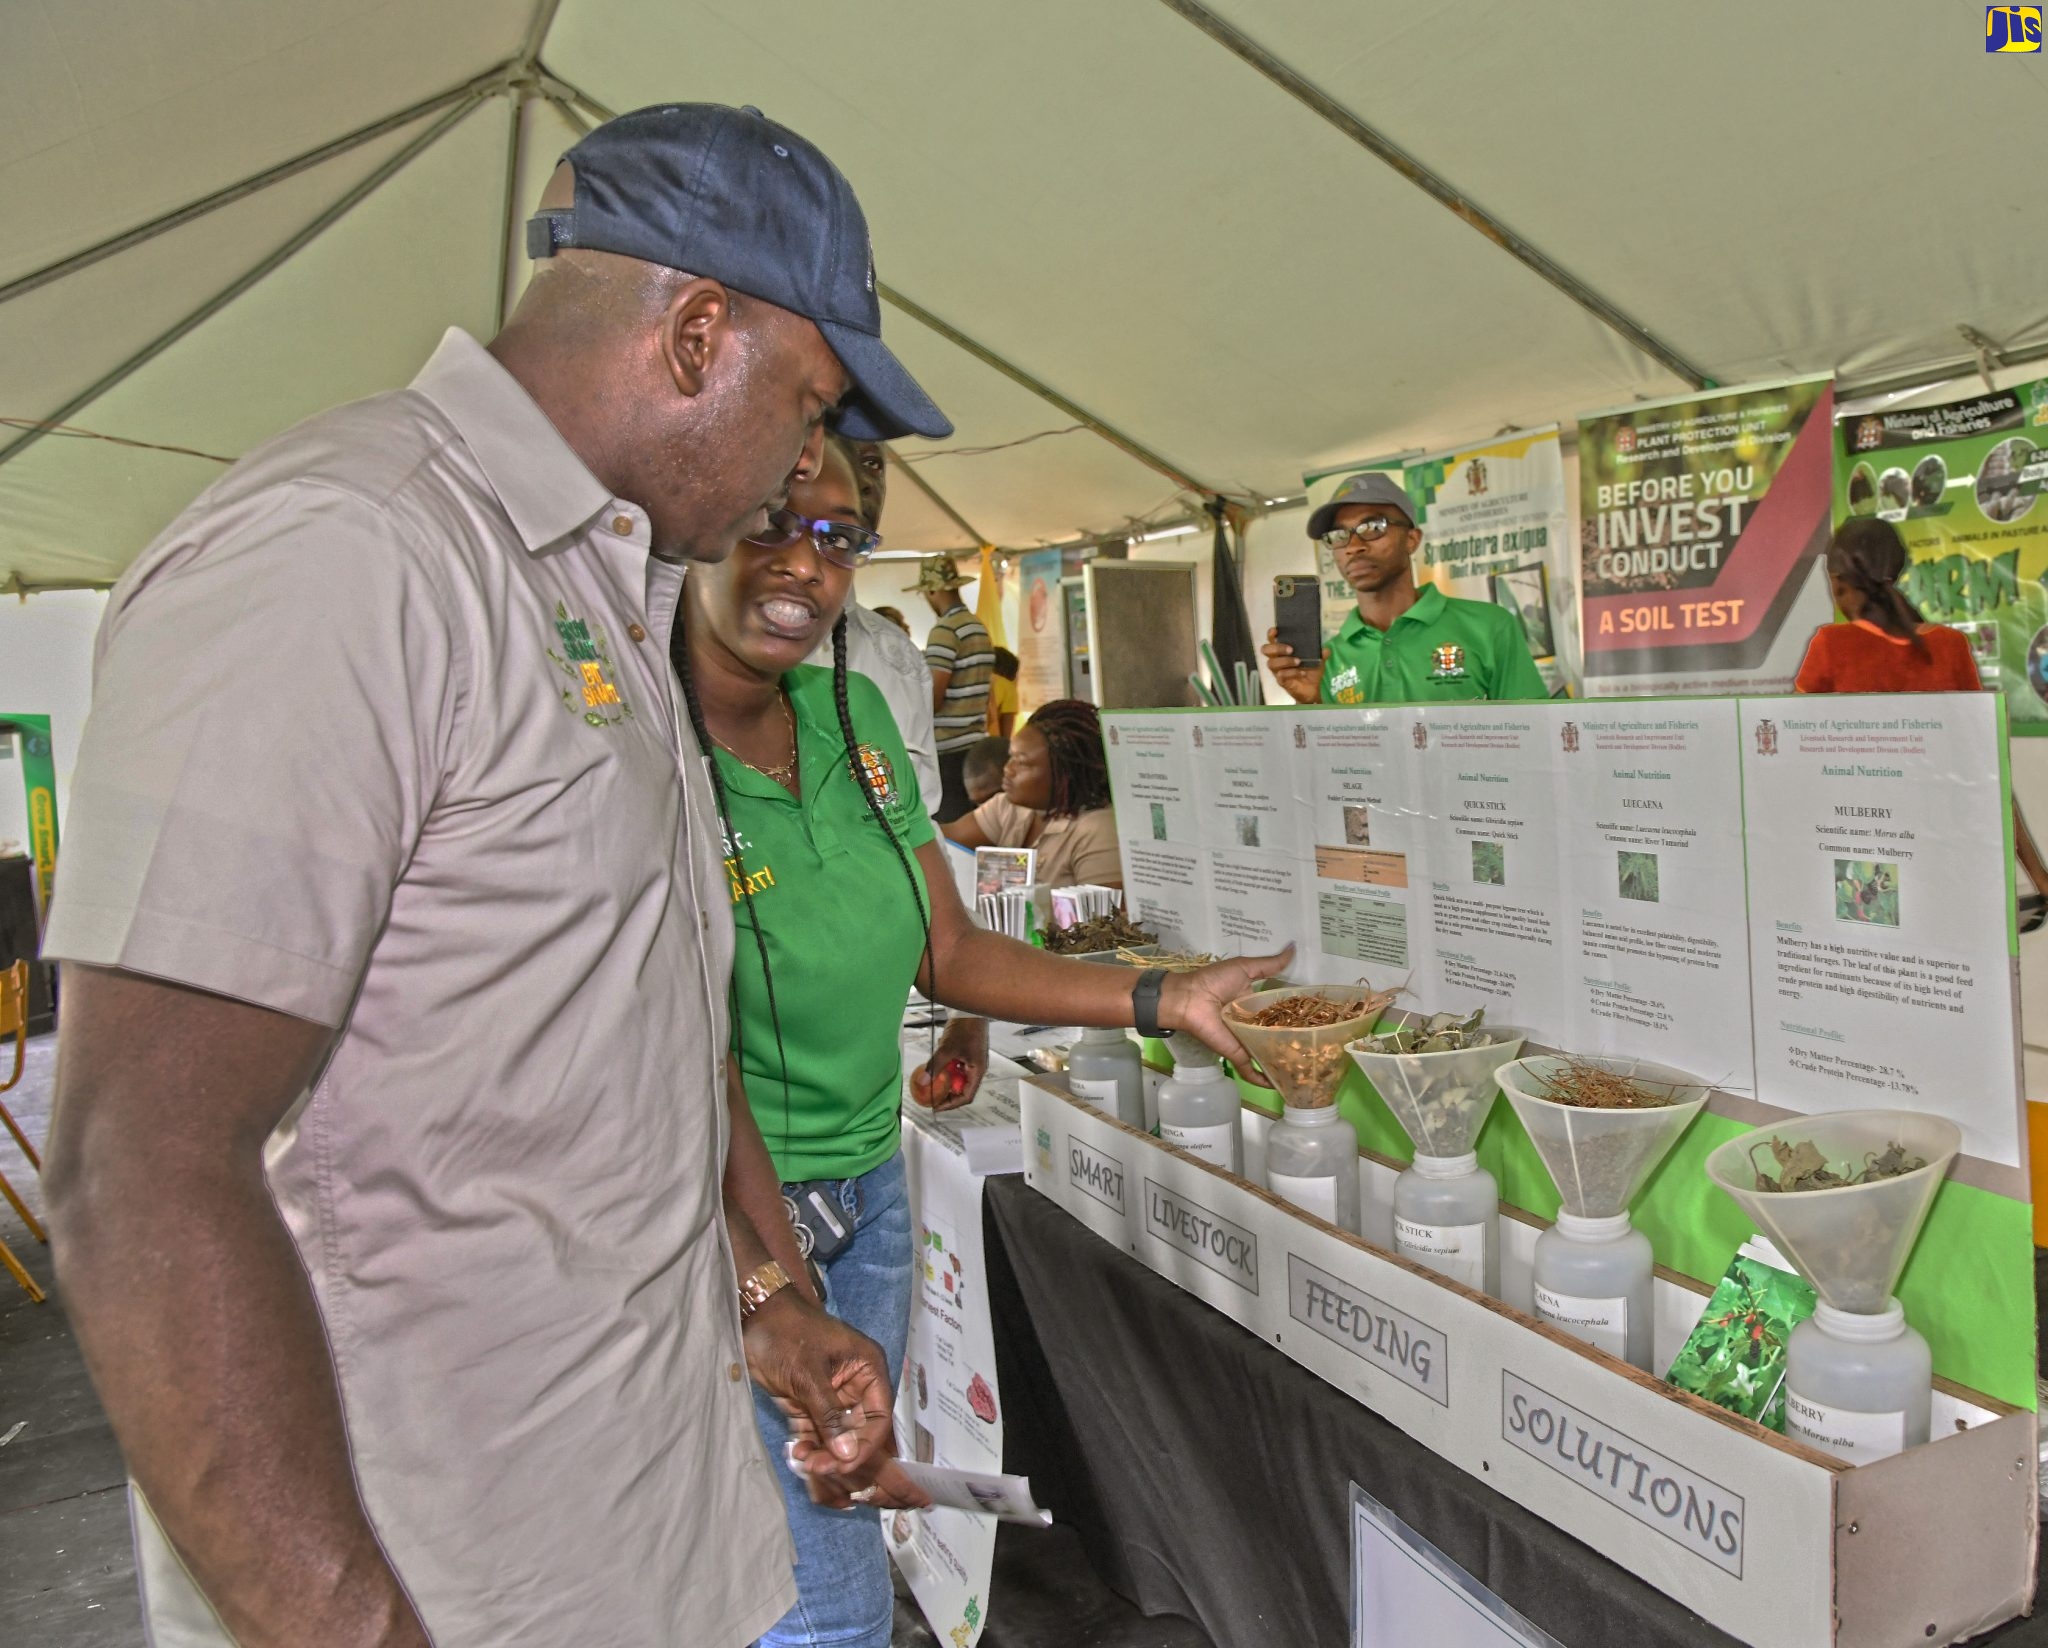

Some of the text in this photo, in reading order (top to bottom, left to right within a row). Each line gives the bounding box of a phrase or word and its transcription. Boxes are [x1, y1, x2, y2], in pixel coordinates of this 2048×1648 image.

[1636, 421, 1671, 434] MINISTRY
[1672, 420, 1683, 429] OF
[1684, 412, 1738, 427] AGRICULTURE
[1746, 404, 1789, 417] FISHERIES
[1884, 398, 2014, 430] Ministry of Agriculture
[1637, 420, 1767, 448] PLANT PROTECTION UNIT
[1912, 417, 1991, 440] and Fisheries
[1616, 432, 1791, 464] Research and Development Division
[1598, 465, 1754, 508] BEFORE YOU
[1598, 494, 1750, 549] INVEST
[1598, 541, 1723, 578] CONDUCT
[1599, 600, 1745, 634] A SOIL TEST
[1582, 720, 1699, 733] Ministry of Agriculture and Fisheries
[1782, 719, 1943, 732] Ministry of Agriculture and Fisheries
[1458, 773, 1508, 783] Animal Nutrition
[1612, 769, 1671, 780] Animal Nutrition
[1821, 765, 1903, 778] Animal Nutrition
[1464, 800, 1506, 810] QUICK STICK
[1622, 799, 1663, 809] LUECAENA
[1834, 805, 1893, 819] MULBERRY
[1815, 824, 1915, 840] Scientific name: Morus alba
[1819, 842, 1914, 860] Common name: Mulberry
[731, 866, 776, 902] ART!
[1776, 920, 1803, 932] Benefits
[1777, 936, 1808, 950] Mulberry
[1810, 941, 1822, 950] has
[1830, 944, 1845, 954] high
[1847, 948, 1878, 958] nutritive
[1880, 952, 1900, 961] value
[1902, 955, 1916, 964] and
[1918, 956, 1925, 965] is
[1927, 959, 1960, 971] superior
[1962, 963, 1971, 972] to
[1777, 950, 1812, 961] traditional
[1814, 954, 1840, 966] forages.
[1843, 958, 1857, 968] The
[1858, 961, 1872, 971] leaf
[1874, 963, 1882, 972] of
[1883, 965, 1897, 974] this
[1898, 968, 1918, 978] plant
[1920, 970, 1926, 979] is
[1935, 975, 1954, 985] good
[1956, 976, 1974, 987] feed
[1778, 963, 1963, 999] ingredient for ruminants because of its high level of
[1778, 988, 1803, 1000] energy.
[1778, 976, 1965, 1014] crude protein and high digestibility of nutrients and
[1795, 1047, 1808, 1059] Dry
[1809, 1050, 1833, 1063] Matter
[1795, 1059, 1817, 1073] Crude
[1818, 1064, 1844, 1078] Protein
[1846, 1071, 1886, 1089] Percentage
[1071, 1149, 1123, 1201] SMART
[1152, 1191, 1254, 1277] LIVESTOCK
[1404, 1226, 1433, 1239] STICK
[1306, 1278, 1431, 1384] FEEDING
[1556, 1313, 1609, 1327] leucocephala
[1802, 1426, 1855, 1448] Morus alba
[1508, 1393, 1741, 1556] SOLUTIONS
